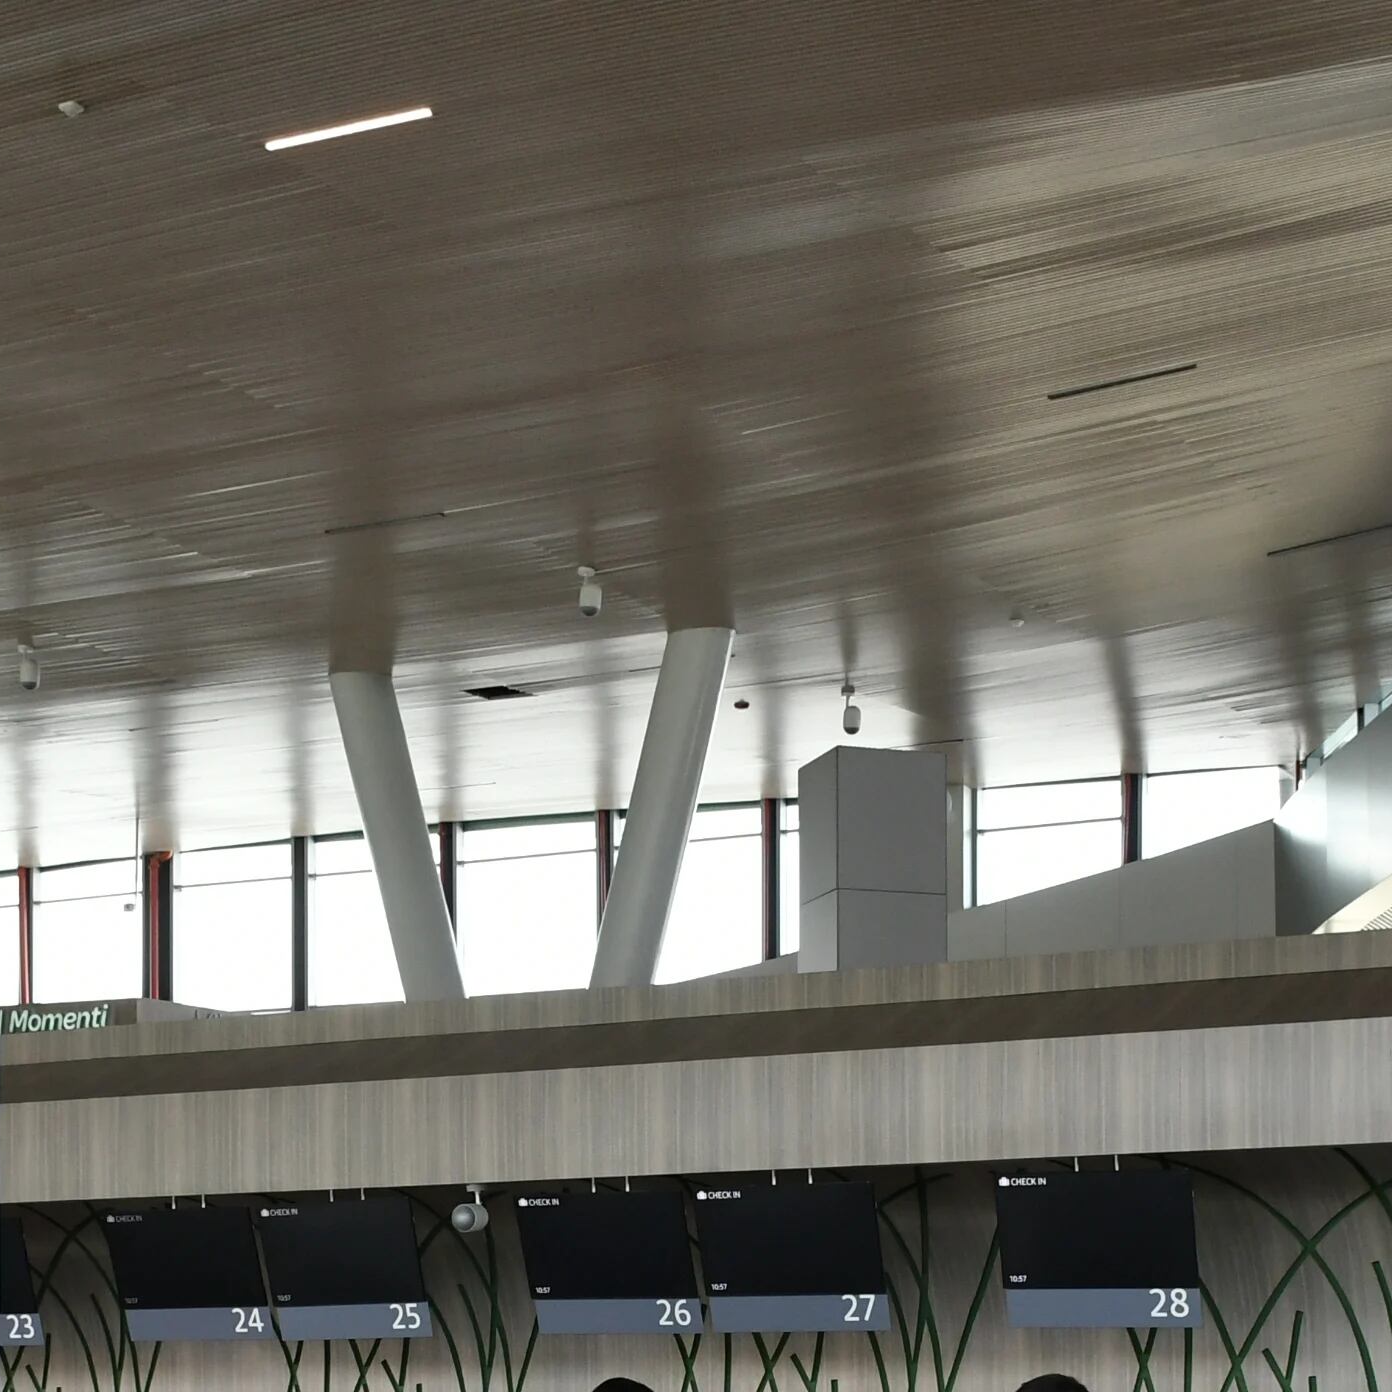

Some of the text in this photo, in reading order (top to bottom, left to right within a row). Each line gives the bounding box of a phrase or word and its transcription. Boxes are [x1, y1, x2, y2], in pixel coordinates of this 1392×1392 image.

[9, 1004, 109, 1032] Momenti
[1010, 1177, 1047, 1186] CHECK IN
[1009, 1275, 1027, 1283] 10:57
[390, 1302, 421, 1330] 25
[656, 1299, 692, 1326] 26
[841, 1294, 877, 1323] 27
[1149, 1288, 1190, 1318] 28
[6, 1314, 35, 1340] 23
[231, 1307, 265, 1333] 24
